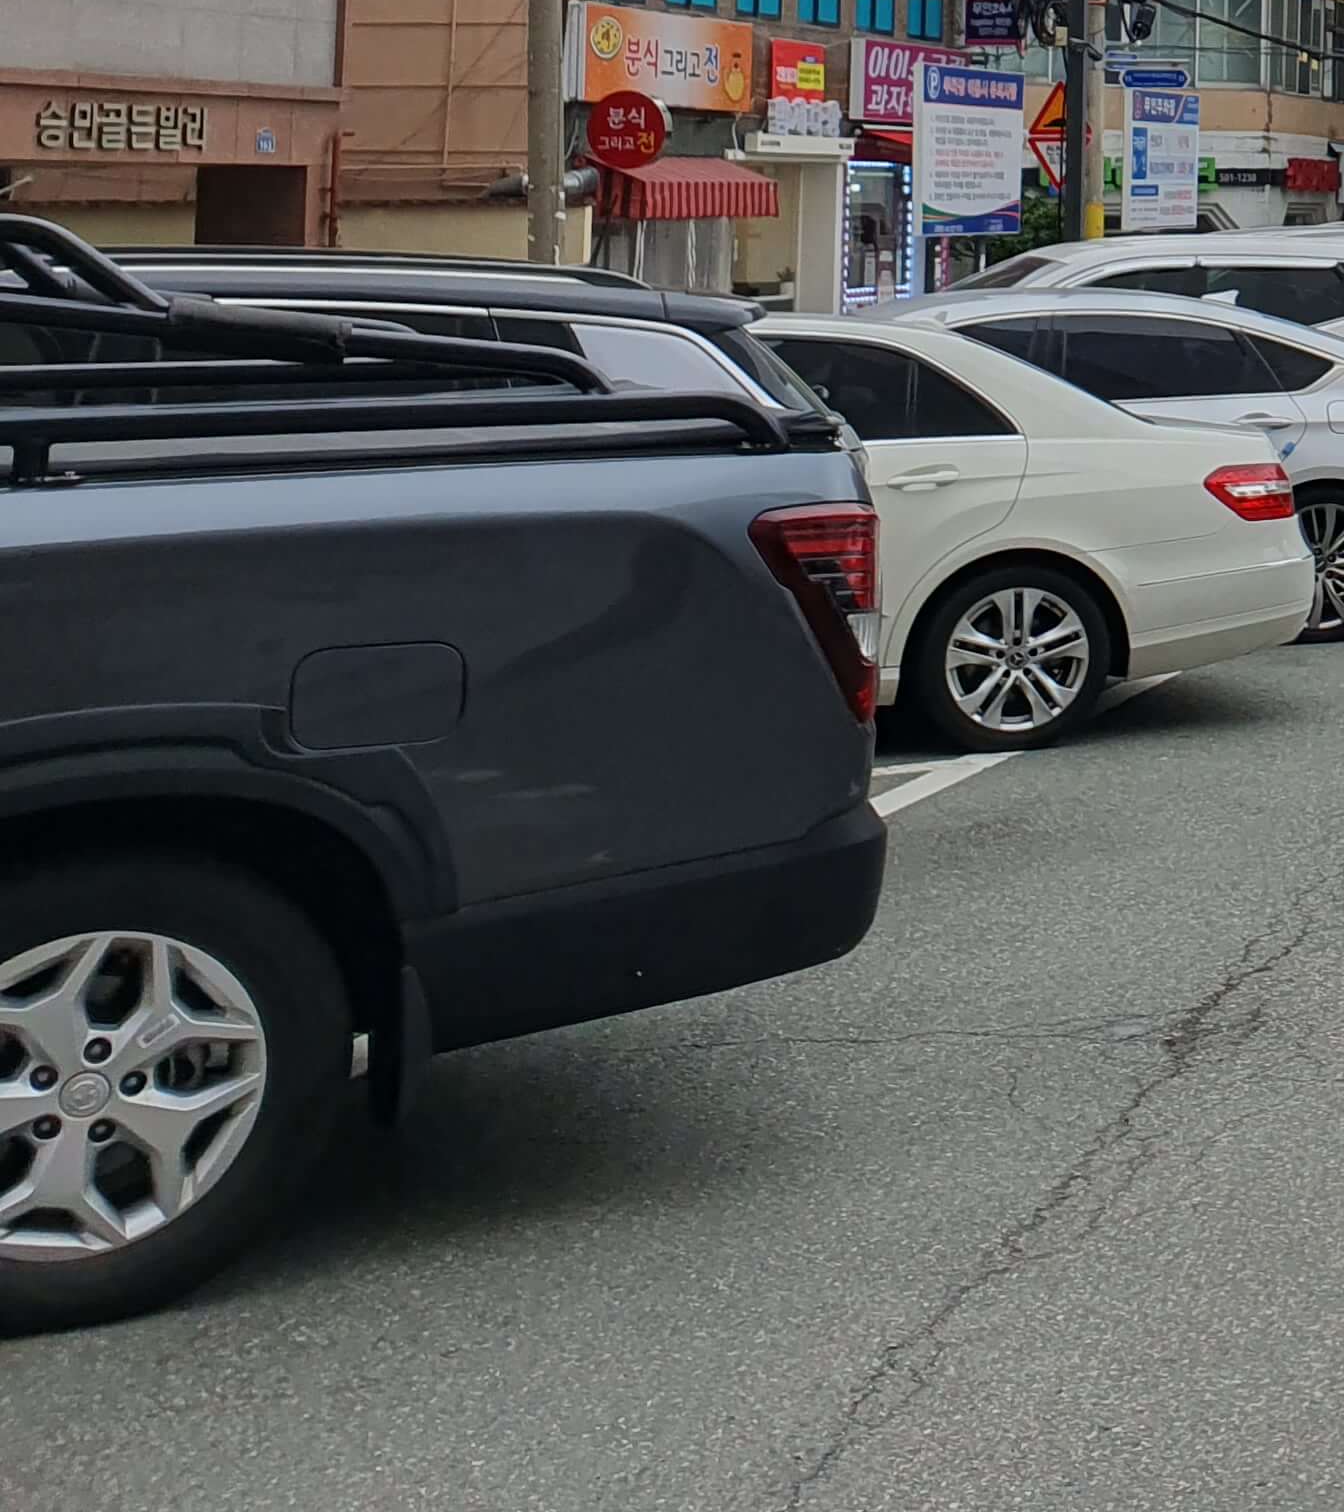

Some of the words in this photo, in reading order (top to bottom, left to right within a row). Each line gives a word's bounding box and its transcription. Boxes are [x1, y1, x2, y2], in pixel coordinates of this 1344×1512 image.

[624, 38, 661, 79] 분식
[660, 48, 701, 80] 그리고
[703, 44, 720, 85] 전
[607, 107, 646, 129] 분식
[599, 136, 635, 152] 그리고
[637, 132, 655, 153] 전
